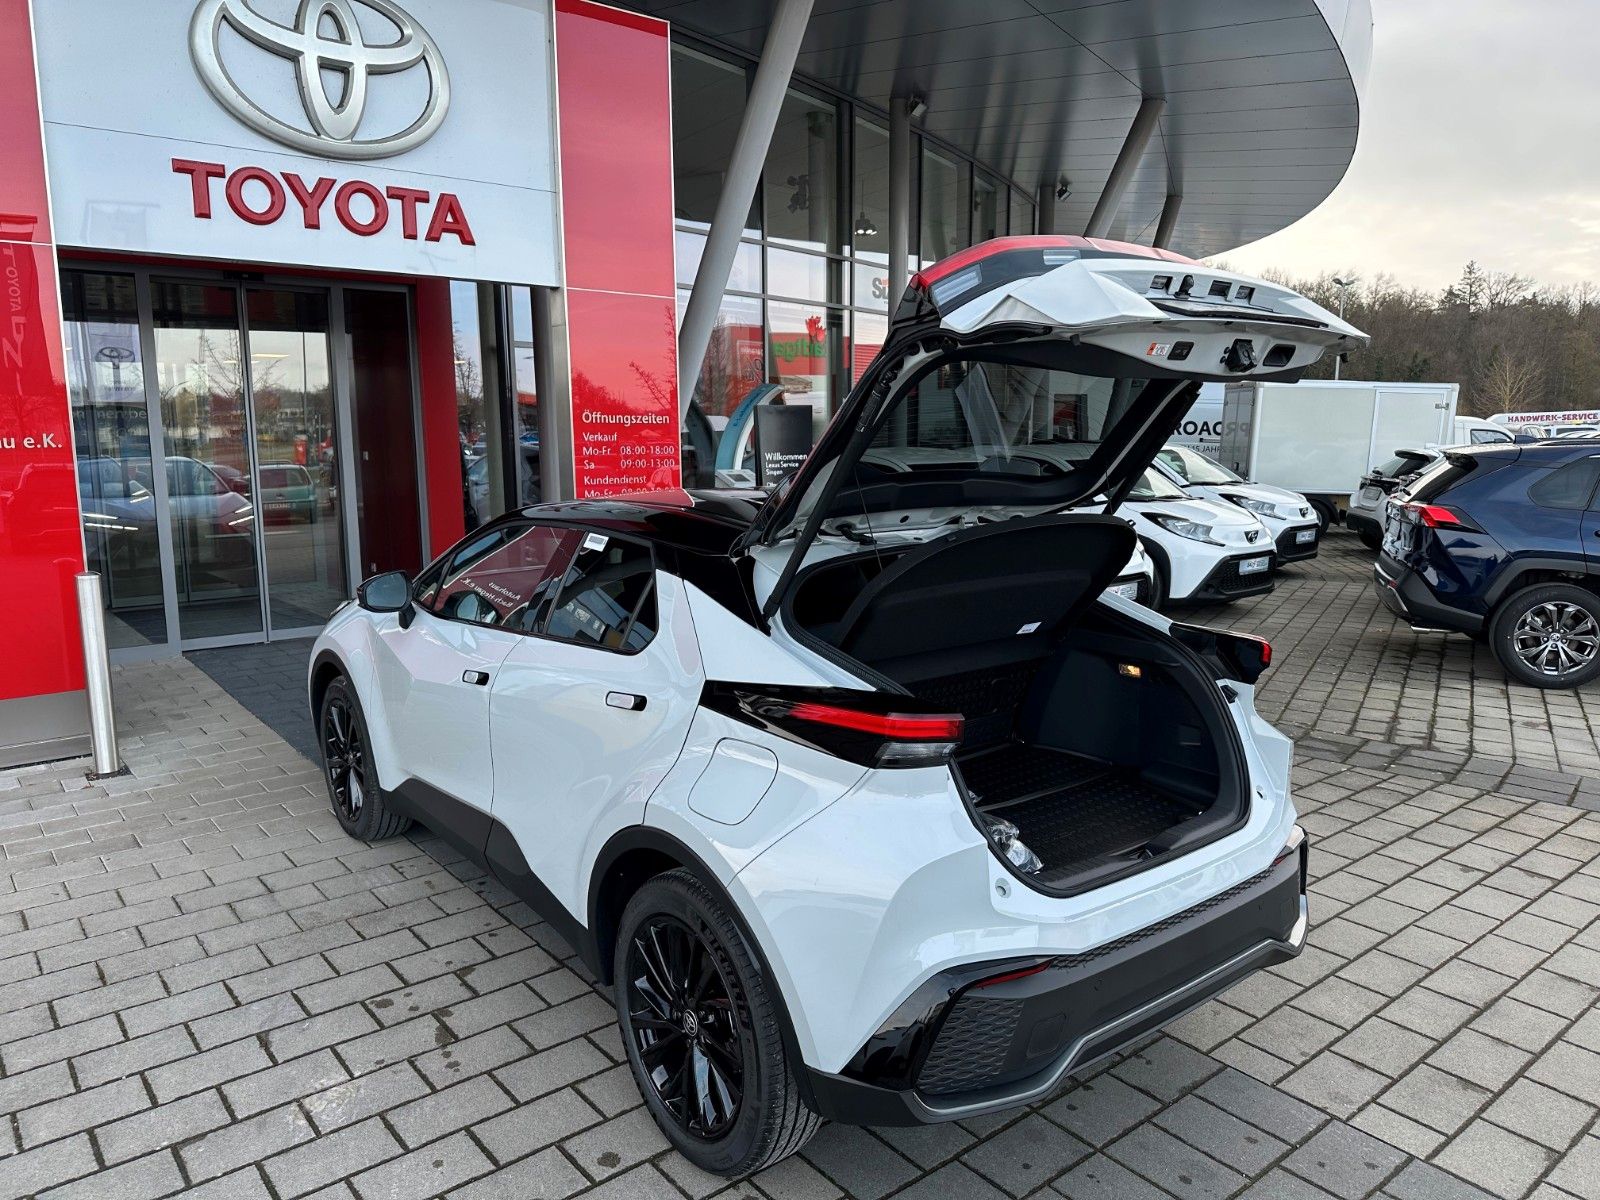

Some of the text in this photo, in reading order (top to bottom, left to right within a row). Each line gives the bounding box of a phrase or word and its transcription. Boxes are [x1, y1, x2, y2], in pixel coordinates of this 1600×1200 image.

[171, 157, 477, 246] TOYOTA
[582, 409, 670, 427] Öffnungszeiten
[1507, 412, 1598, 422] HANDWERK-SERVICE
[23, 433, 62, 449] e.K.
[582, 432, 617, 441] Verkauf
[582, 446, 674, 455] Mo-Fr 08:00-18:00
[765, 452, 808, 461] Willkommen
[583, 459, 675, 469] Sa 09:00-13:00
[766, 468, 783, 476] Singen
[584, 475, 646, 485] Kundendienst
